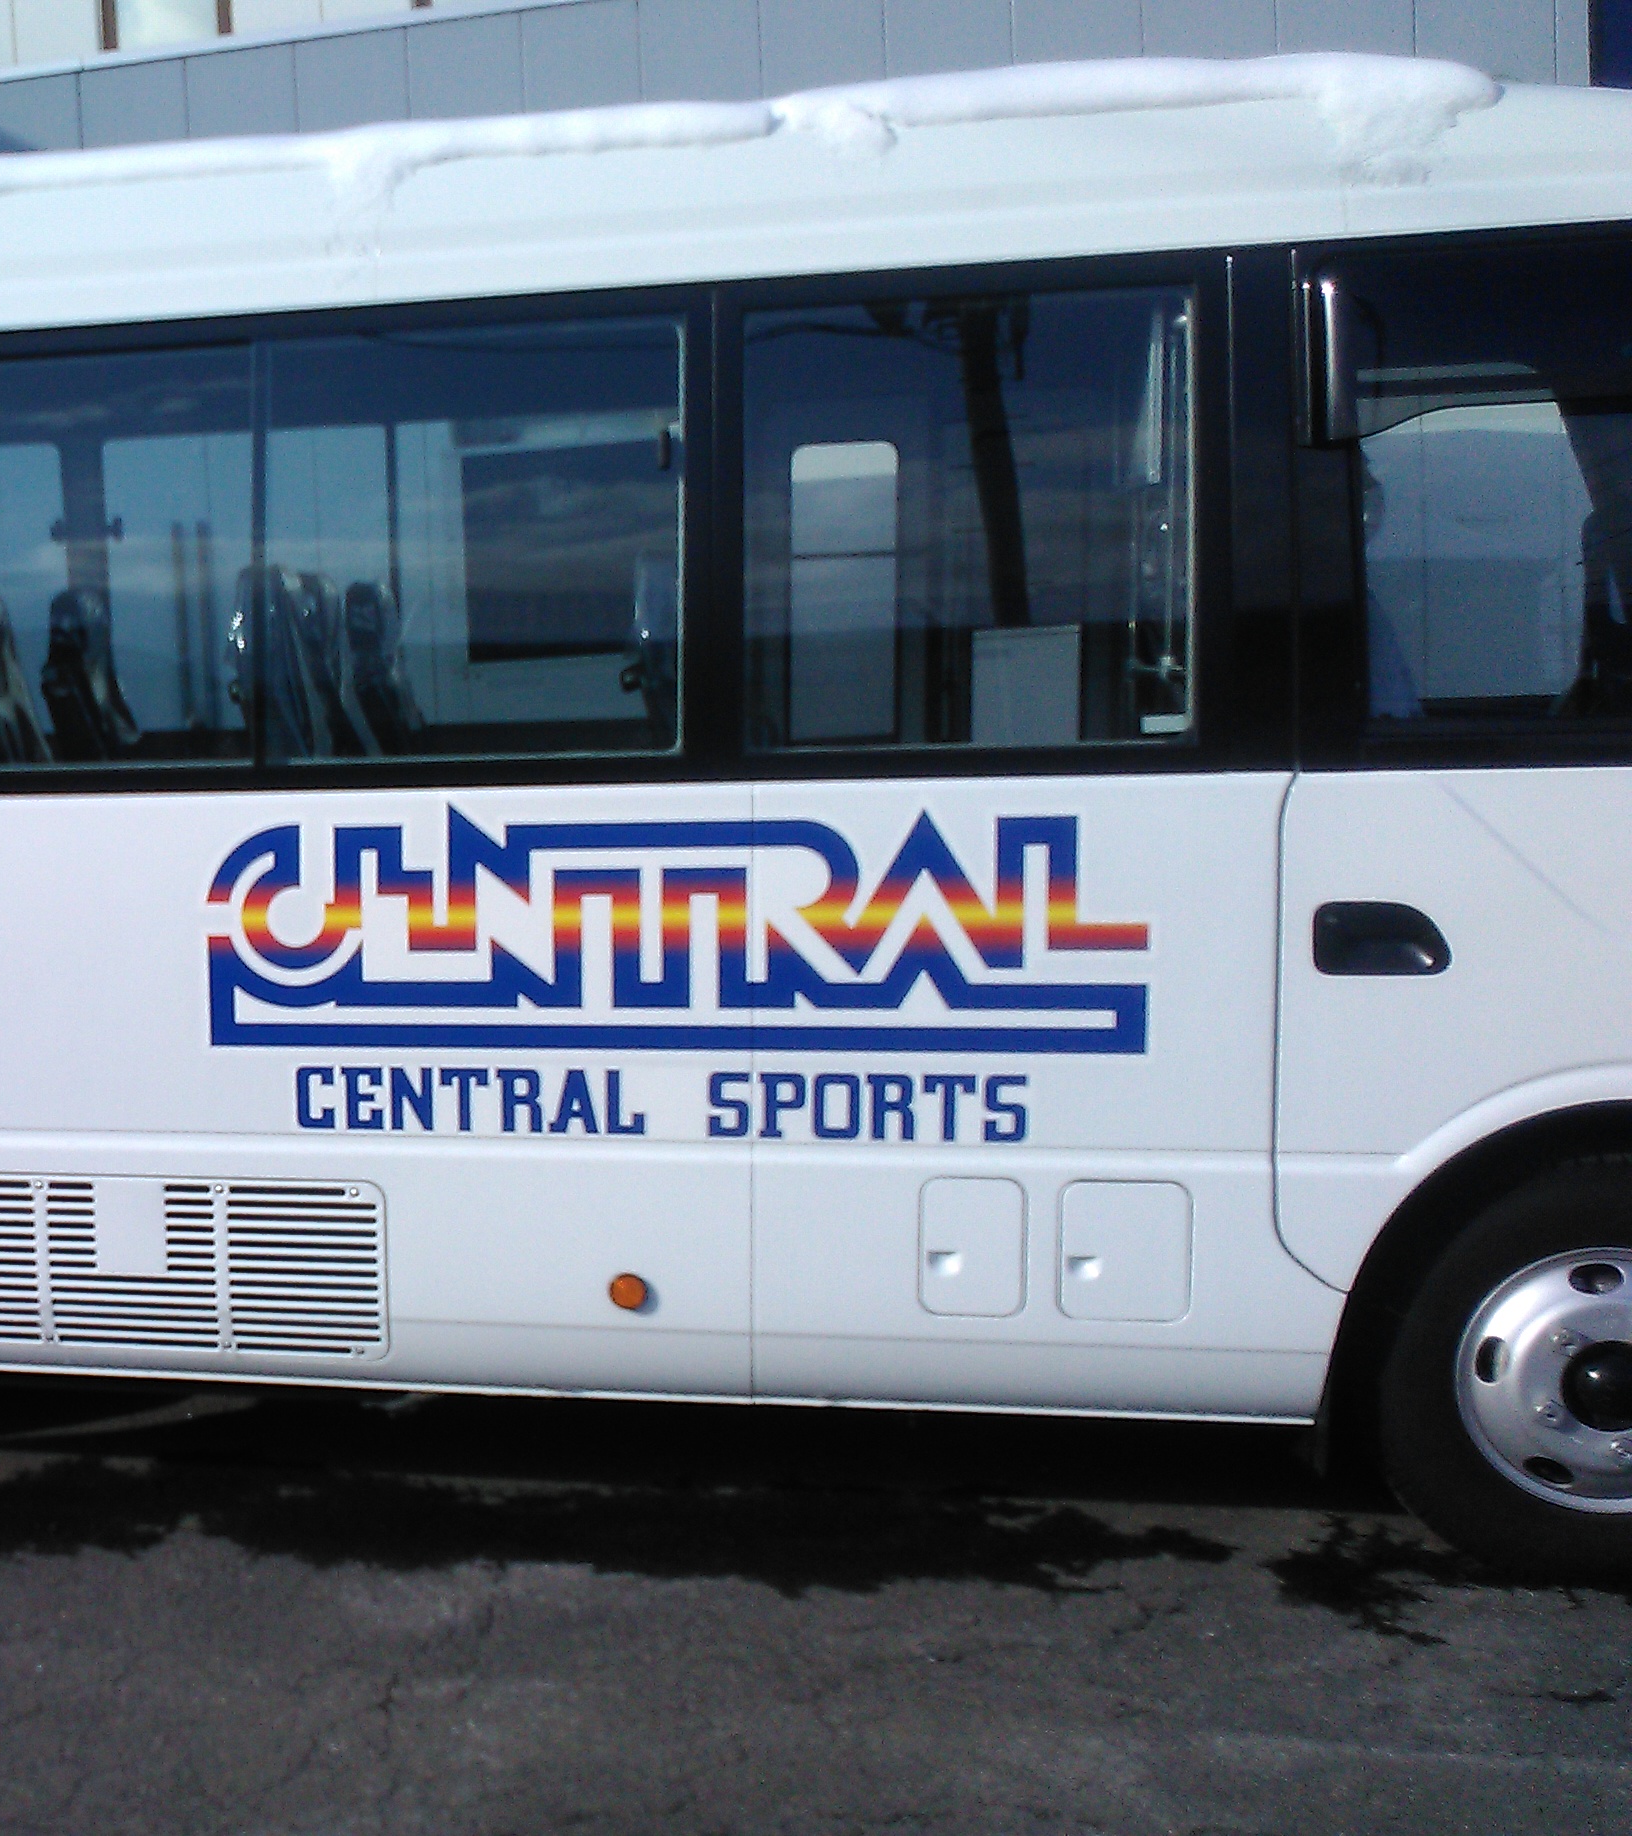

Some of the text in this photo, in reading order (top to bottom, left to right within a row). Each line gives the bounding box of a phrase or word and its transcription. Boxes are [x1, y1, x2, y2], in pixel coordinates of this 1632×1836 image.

[207, 803, 1148, 1053] CENTRAL
[296, 1067, 1028, 1143] CENTRAL SPORTS
